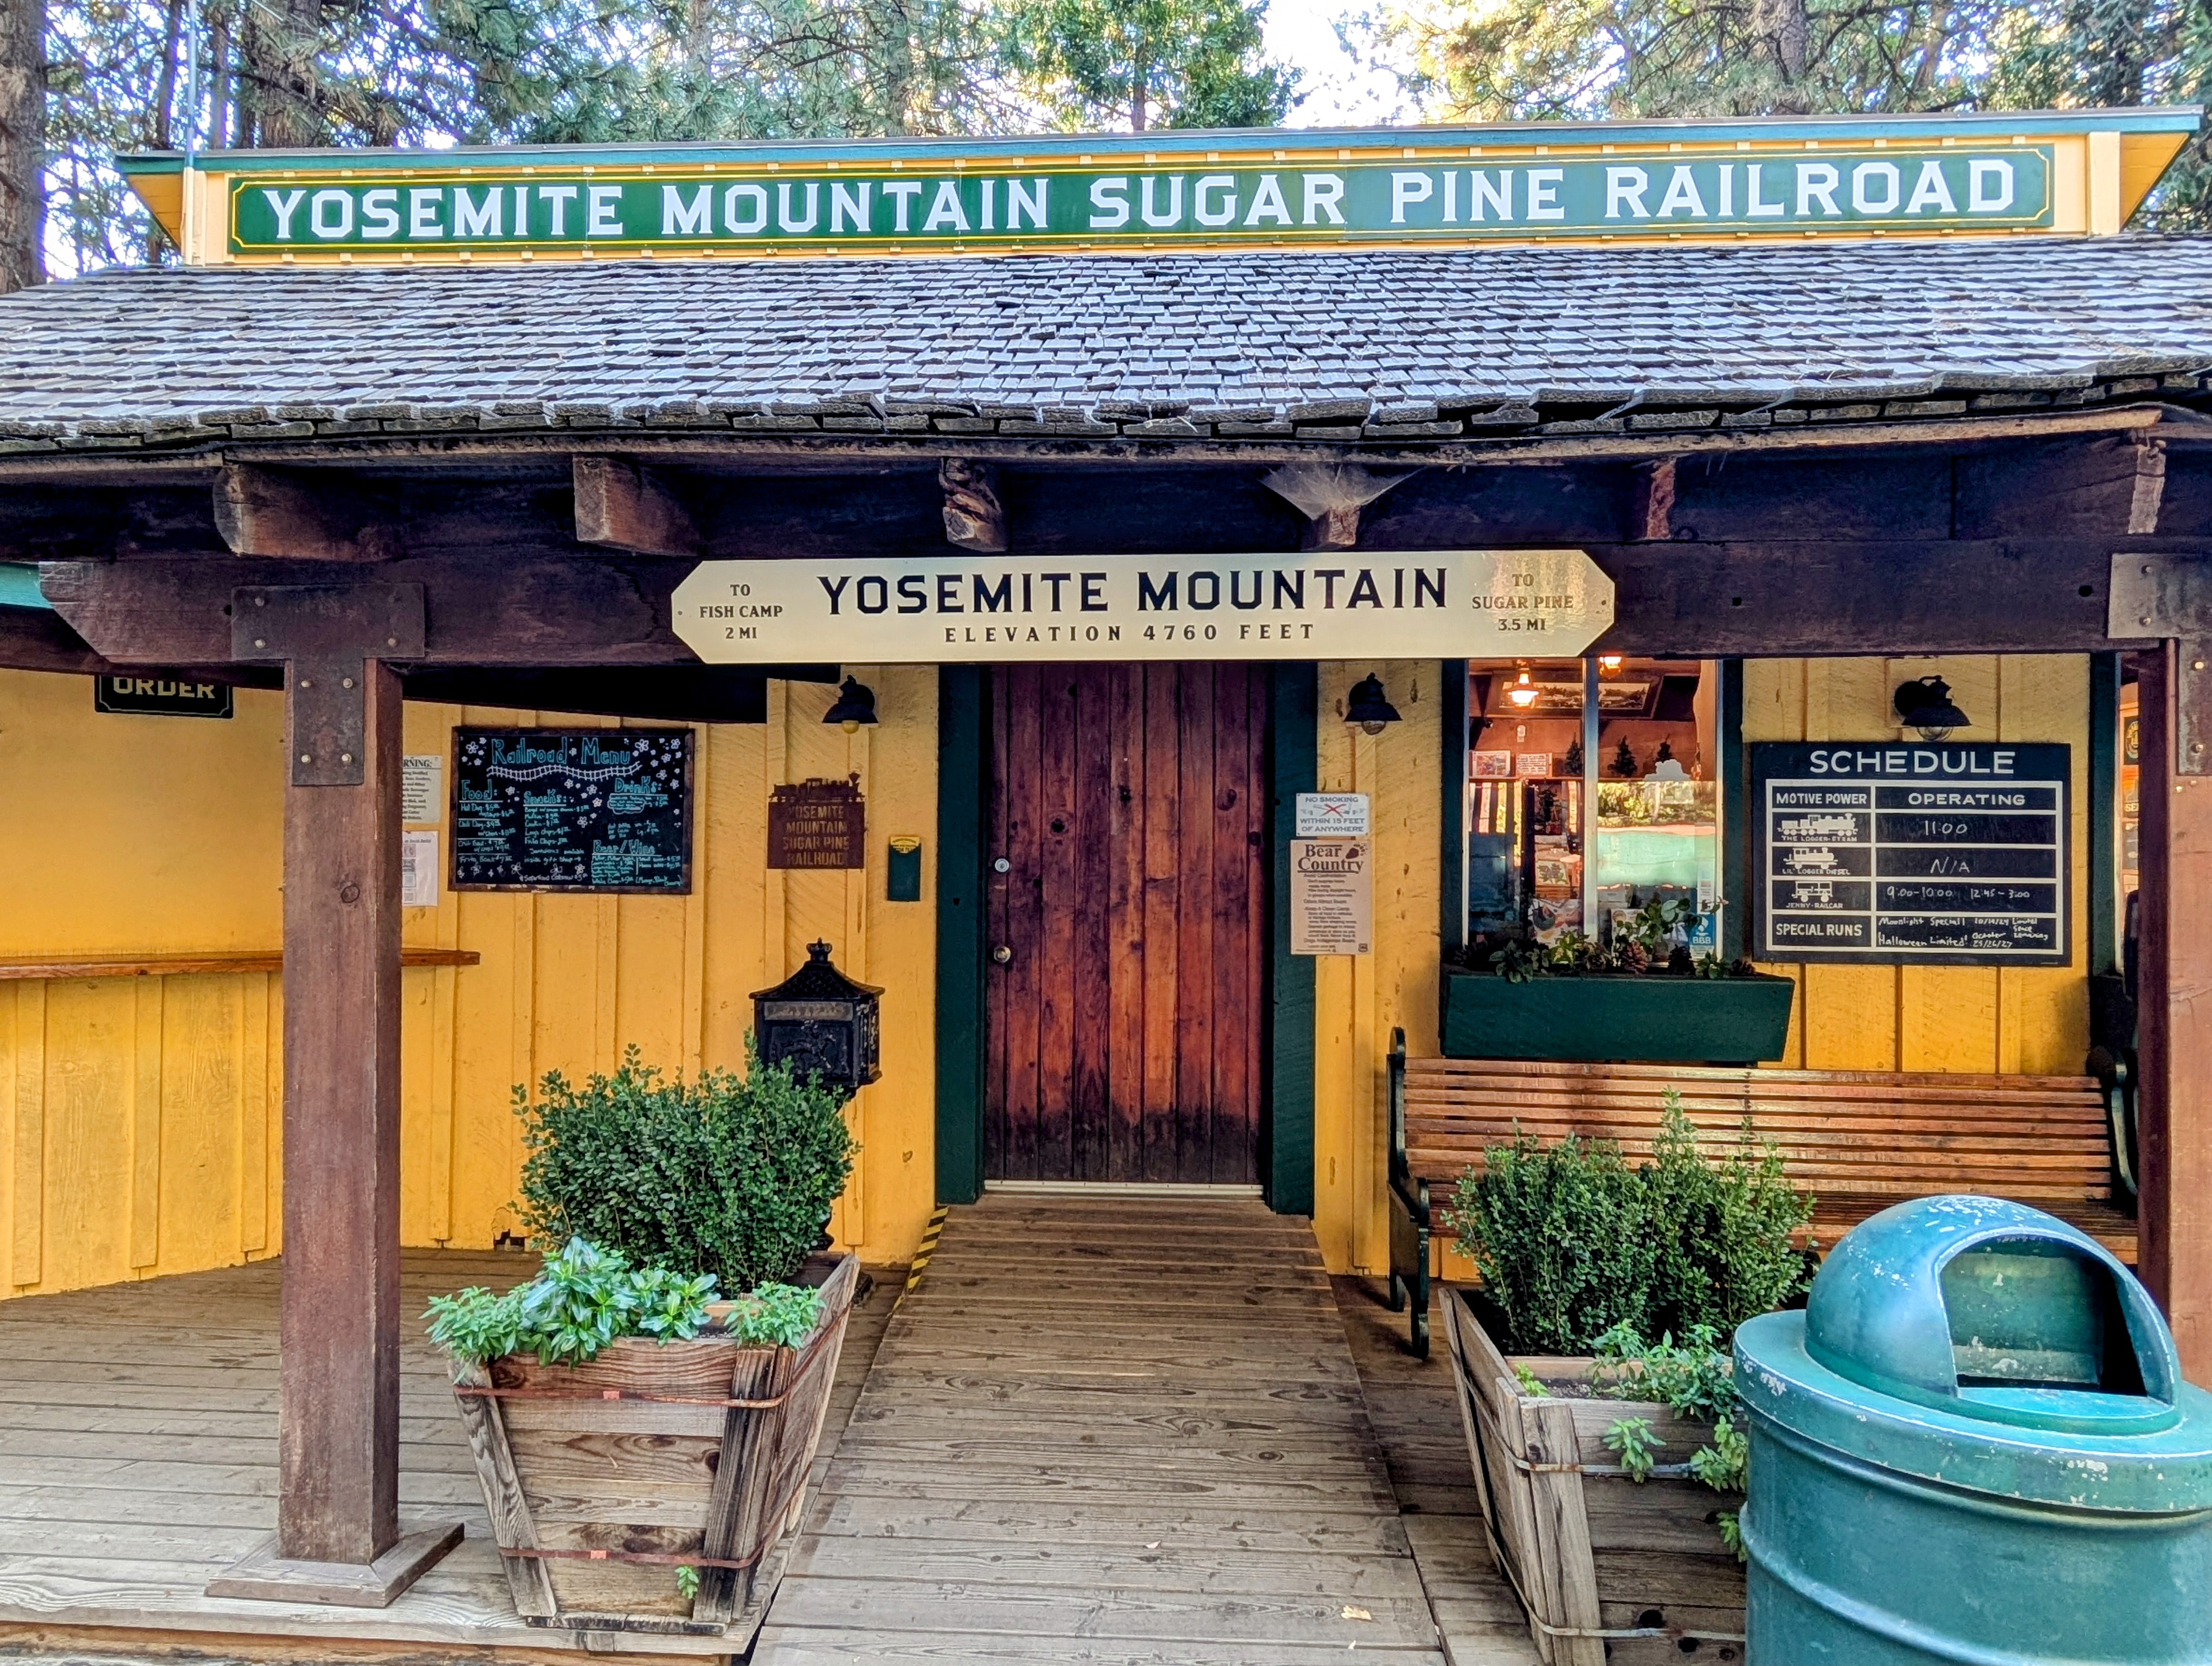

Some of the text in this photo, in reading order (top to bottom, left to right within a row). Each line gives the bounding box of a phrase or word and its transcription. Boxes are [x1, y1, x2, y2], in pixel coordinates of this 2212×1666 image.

[261, 158, 2015, 239] YOSEMITE MOUNTAIN SUGAR PINE RAILROAD
[1512, 573, 1534, 588] TO
[730, 584, 751, 597] TO
[817, 567, 1448, 616] YOSEMITE MOUNTAIN
[1471, 595, 1573, 610] SUGAR PINE
[699, 605, 783, 618] FISH CAMP
[1497, 618, 1547, 631] 3.5 MI
[725, 626, 758, 639] 2 MI
[944, 623, 1315, 643] ELEVATION 4760 FEET
[113, 677, 215, 699] ORDER
[491, 736, 631, 765] Railroad Menu
[1809, 750, 2016, 774] SCHEDULE
[461, 779, 498, 800] Food:
[1776, 793, 1868, 805] MOTIVE POWER
[1908, 792, 2027, 806] OPERATING
[787, 805, 844, 819] YOSEMITE
[786, 821, 847, 835] MOUNTAIN
[1925, 820, 1968, 836] 11:00
[783, 836, 850, 850] SUGAR PINE
[1305, 844, 1343, 857] Bear
[787, 851, 847, 866] RAILROAD
[1297, 857, 1364, 872] Country
[1930, 856, 1970, 874] N/A
[1970, 888, 1995, 900] 12:45
[2008, 889, 2030, 899] 3:00
[1878, 917, 1925, 926] Moonlight
[1776, 923, 1863, 937] SPECIAL RUNS
[1692, 936, 1712, 944] BBB
[1877, 932, 1928, 946] Halloween
